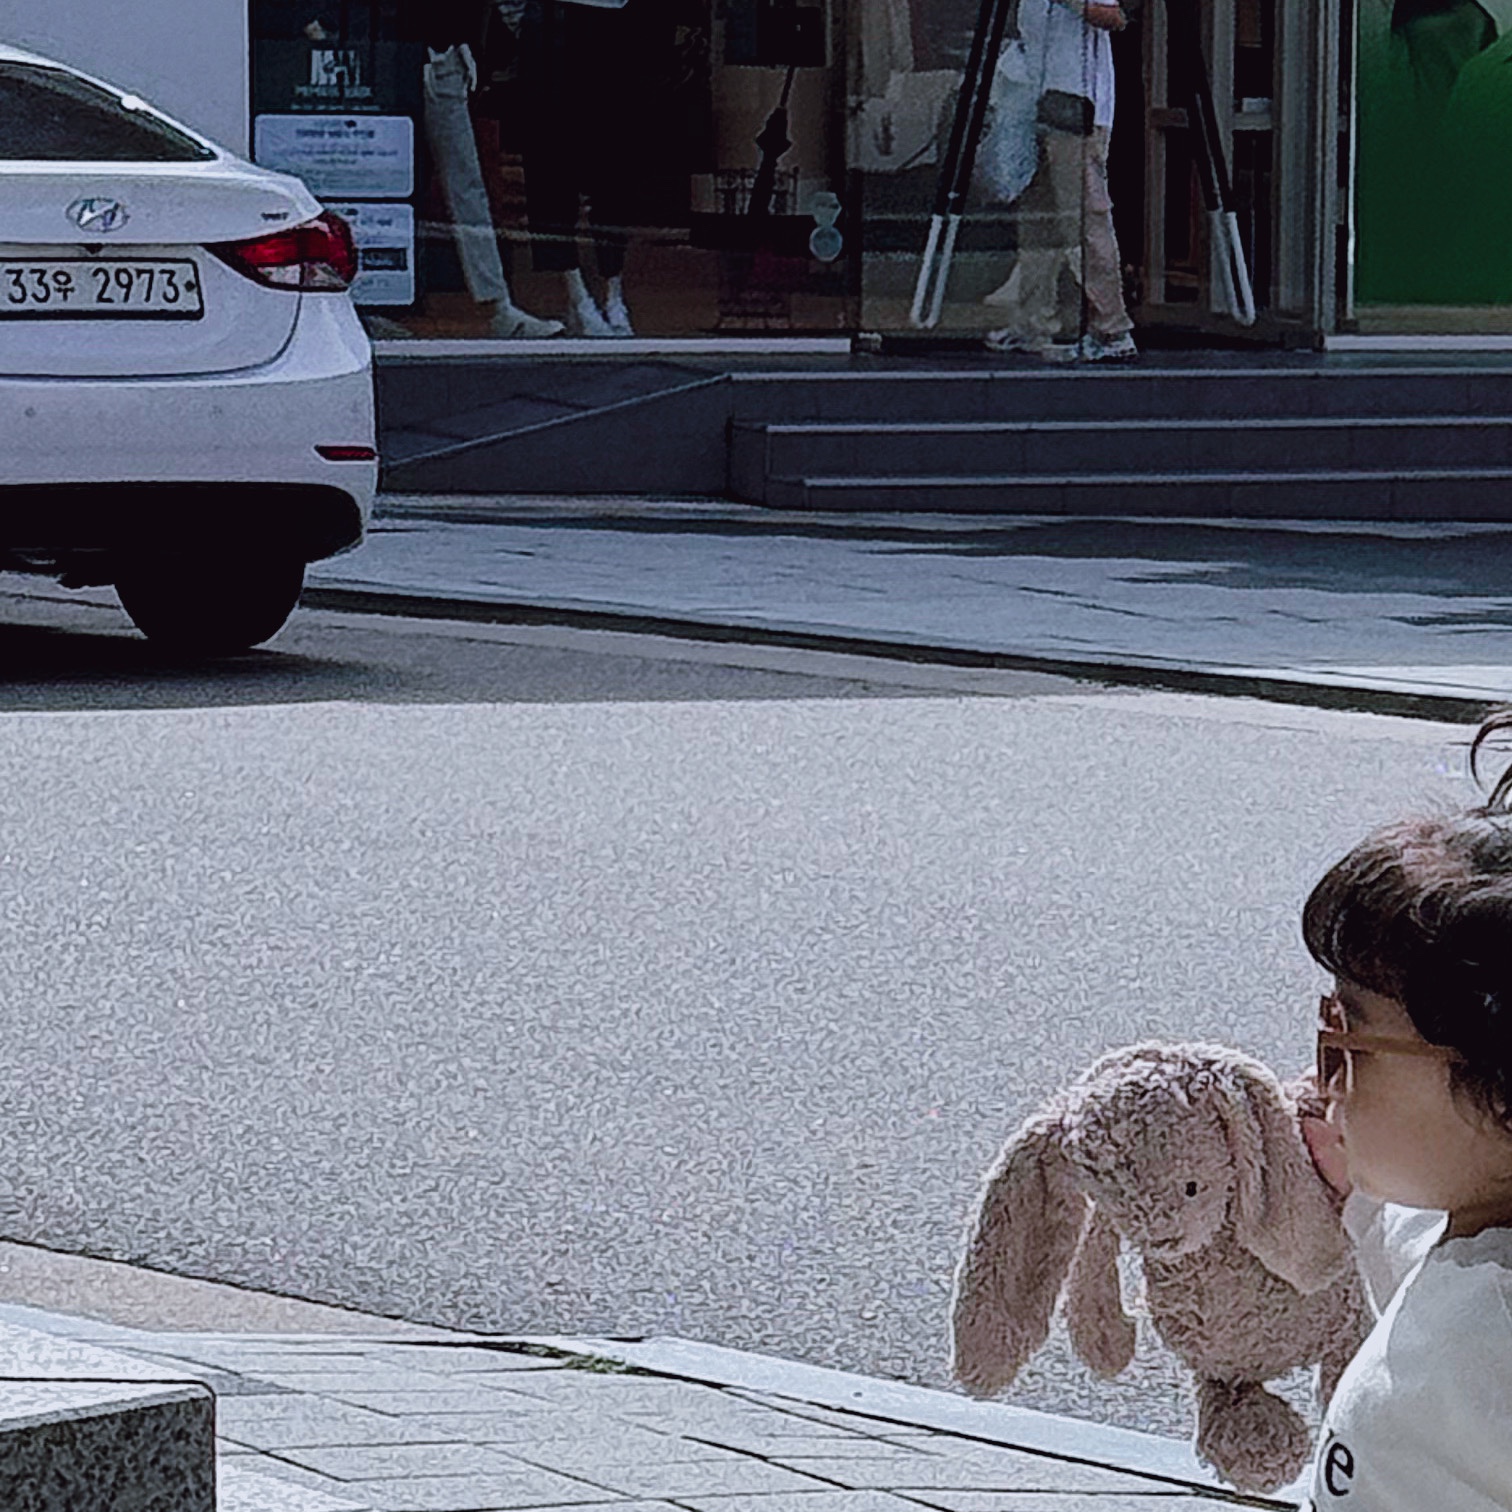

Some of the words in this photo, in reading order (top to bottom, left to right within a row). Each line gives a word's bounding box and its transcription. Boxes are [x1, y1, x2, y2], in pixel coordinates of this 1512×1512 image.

[5, 268, 75, 304] 33우
[92, 267, 180, 303] 2973
[1322, 1429, 1356, 1498] e
